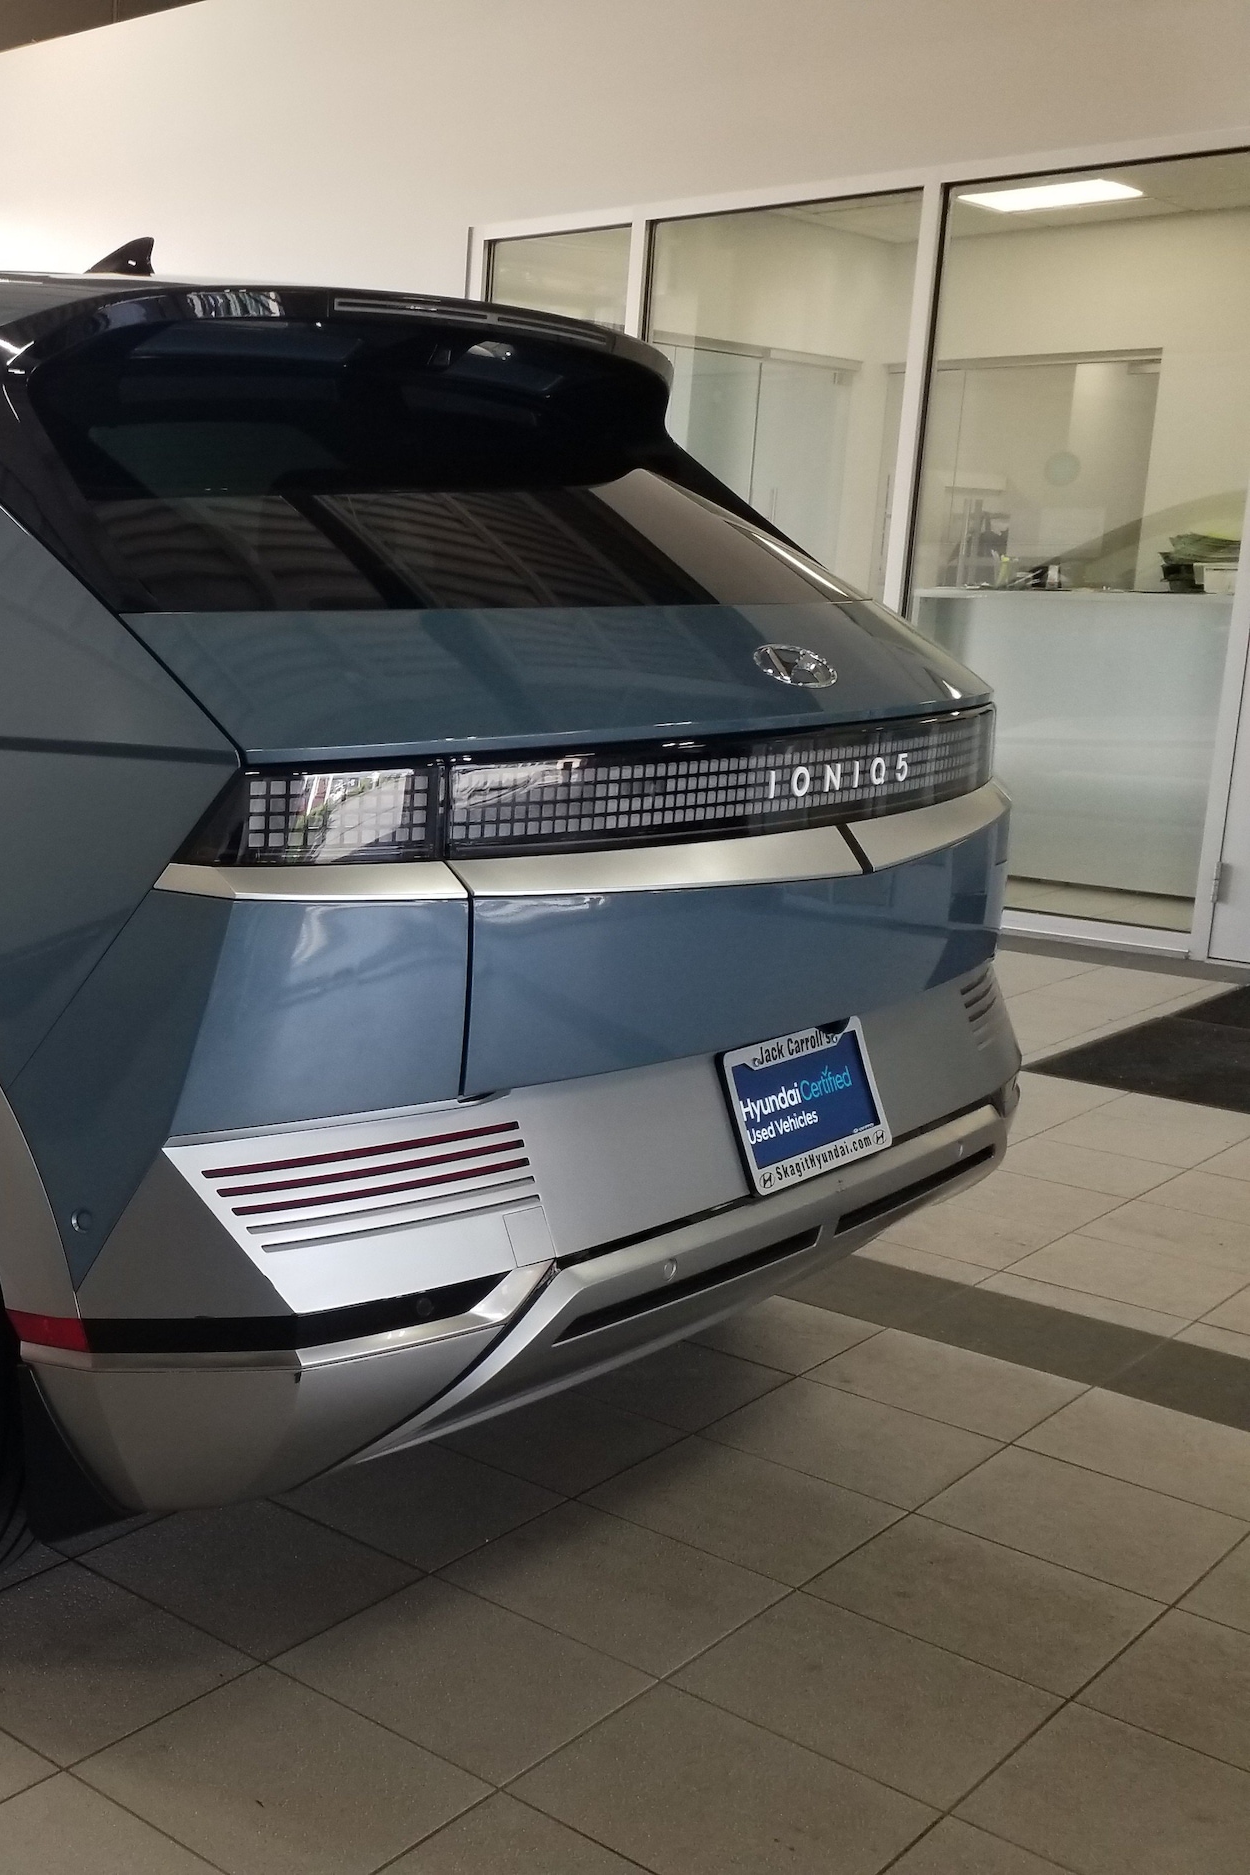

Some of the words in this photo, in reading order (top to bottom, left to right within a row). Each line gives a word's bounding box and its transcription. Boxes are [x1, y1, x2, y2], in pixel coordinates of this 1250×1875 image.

[759, 1041, 785, 1065] Jack
[739, 1082, 801, 1123] Hyundai
[800, 1065, 852, 1102] Certified
[746, 1121, 775, 1145] Used
[774, 1109, 819, 1135] Vehicles
[775, 1134, 873, 1181] SkagitHyundai.com
